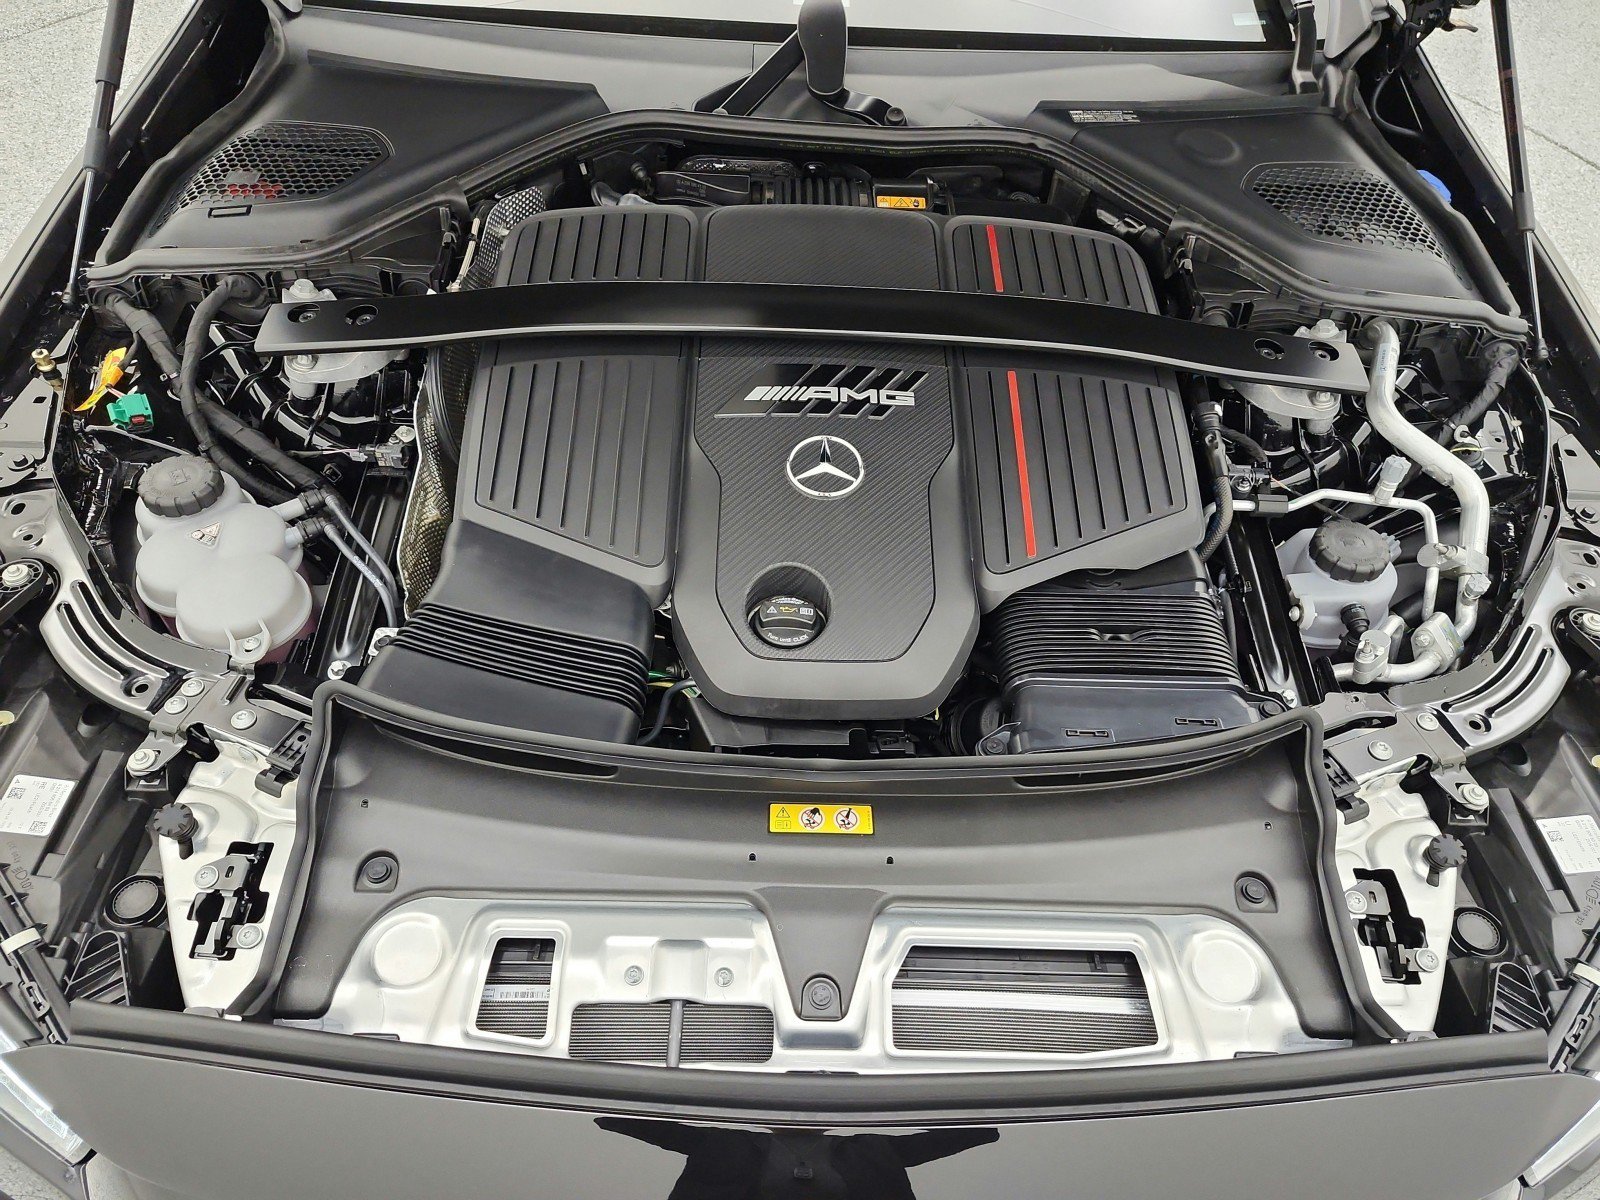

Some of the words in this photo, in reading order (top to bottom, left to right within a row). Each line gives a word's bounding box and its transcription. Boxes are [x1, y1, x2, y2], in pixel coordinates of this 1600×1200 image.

[797, 386, 915, 406] AMG
[767, 632, 779, 641] Turn
[792, 633, 809, 642] CLICK
